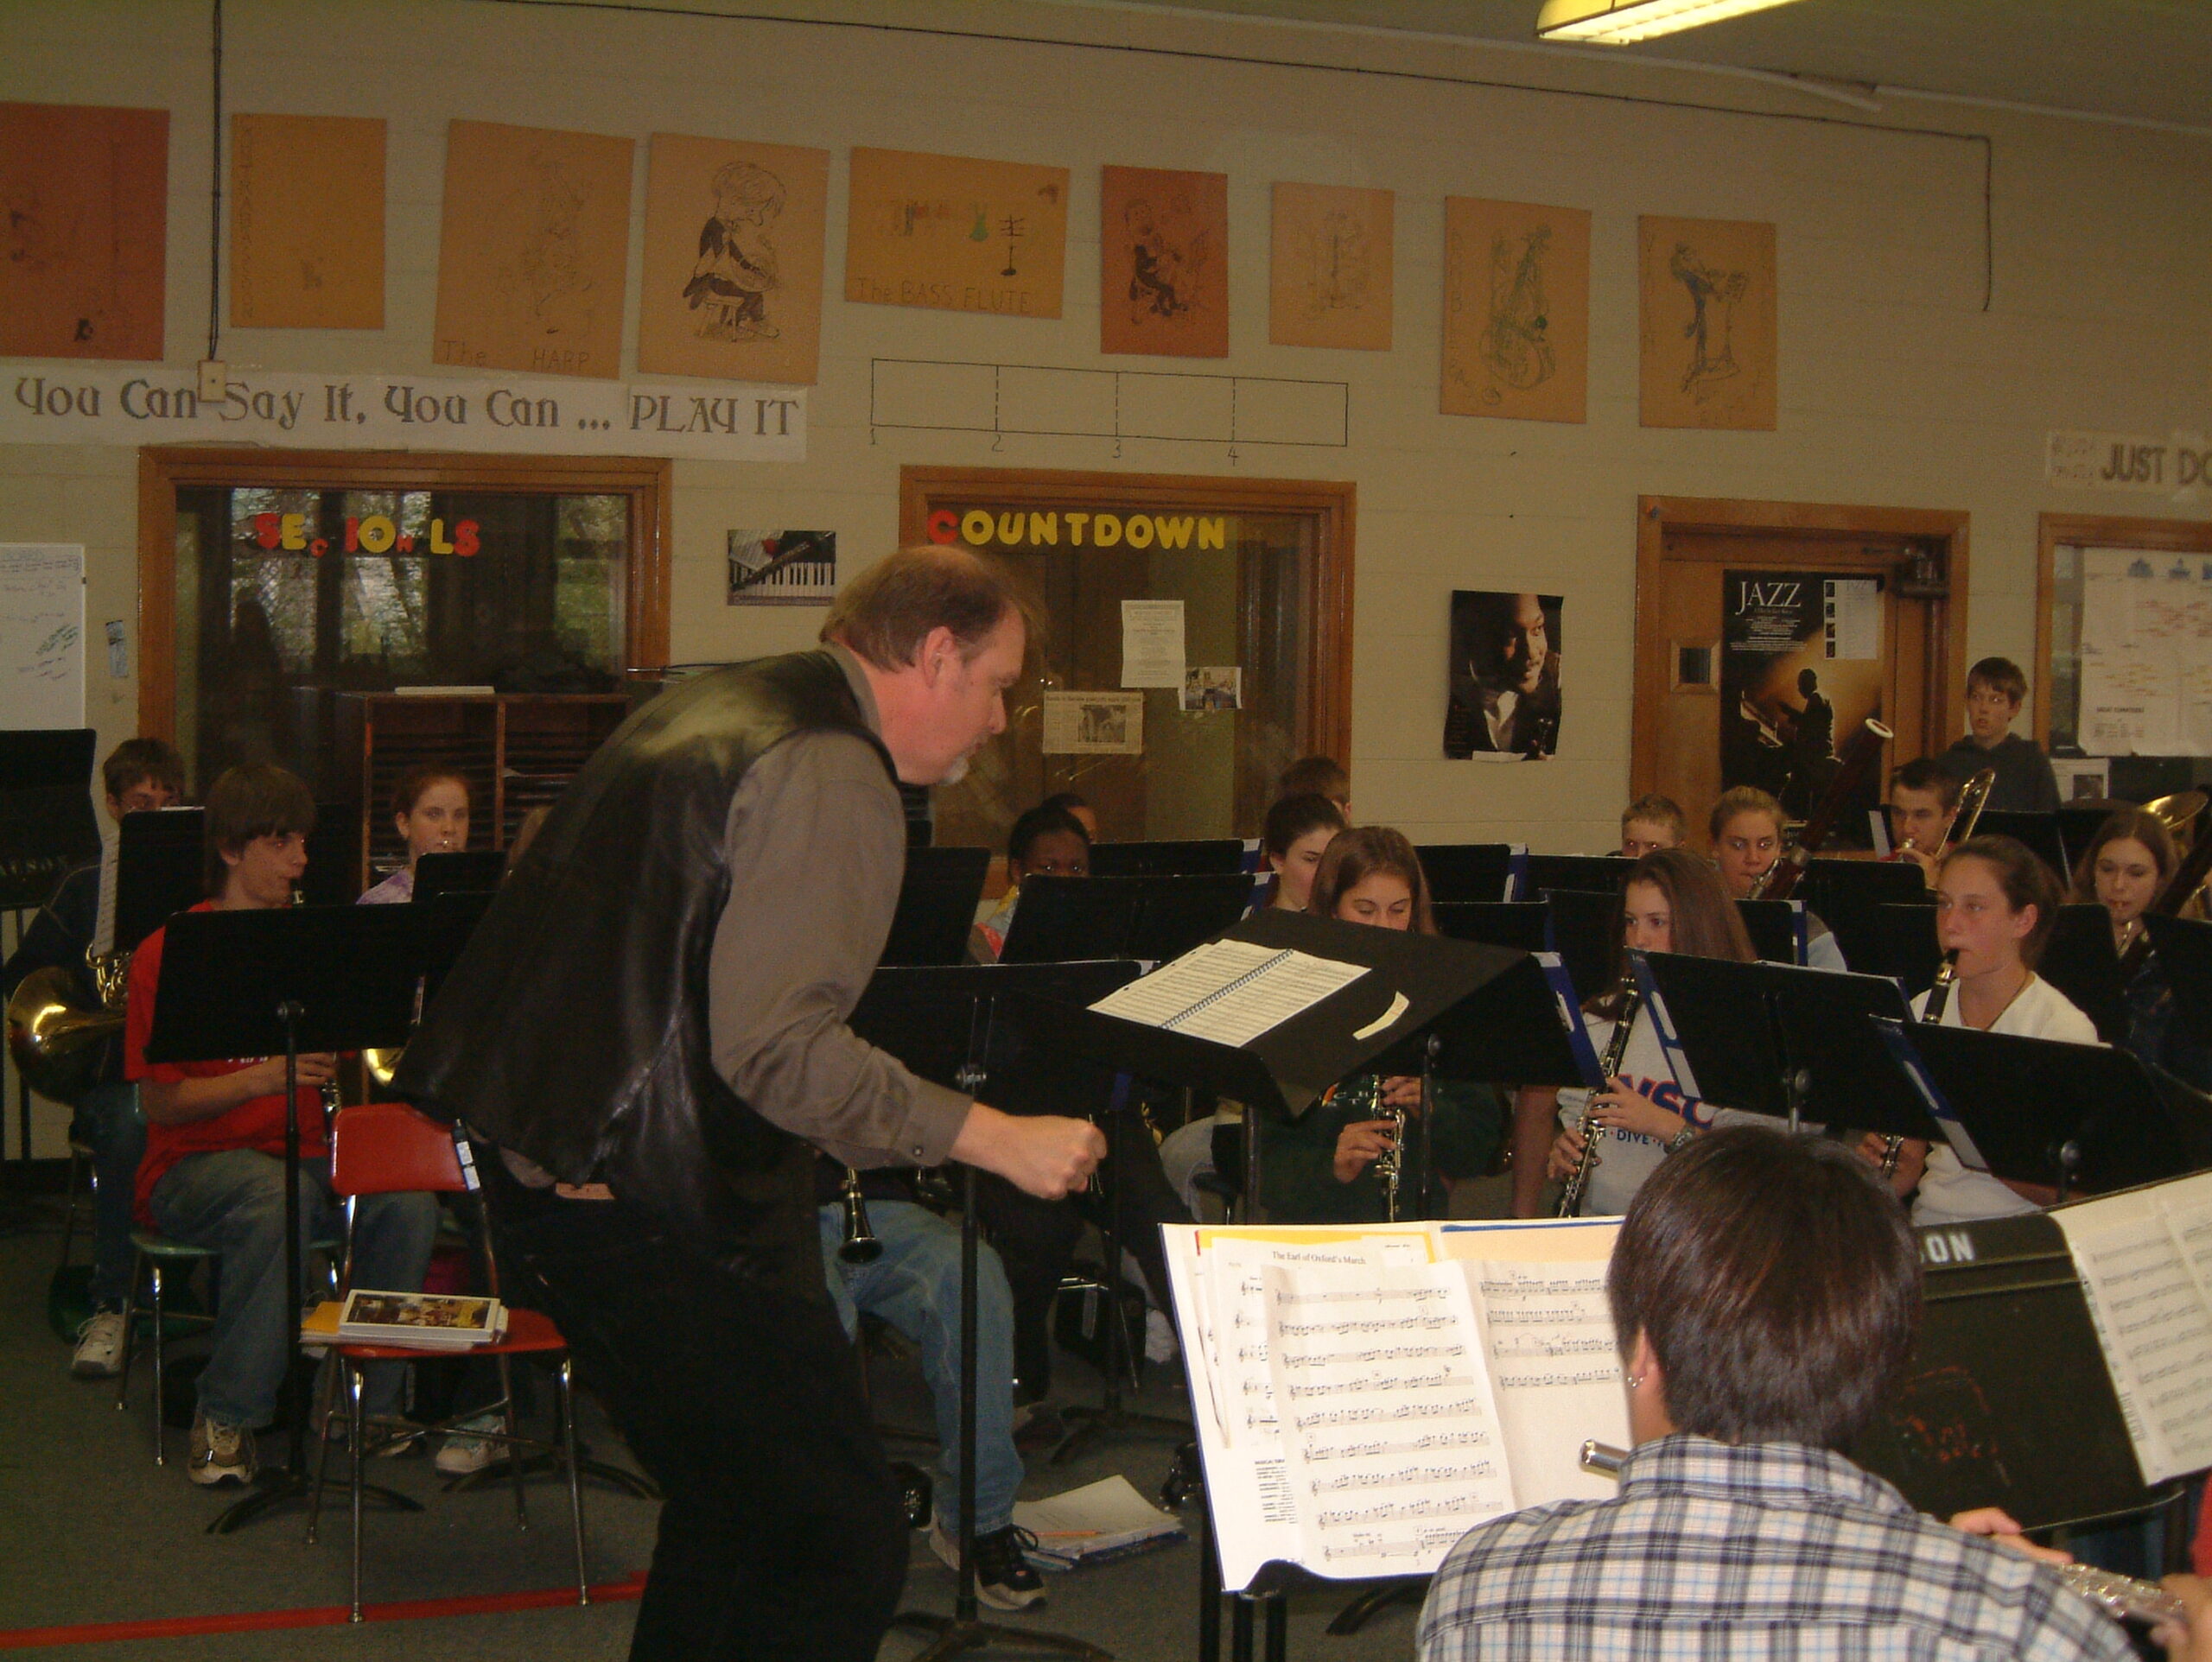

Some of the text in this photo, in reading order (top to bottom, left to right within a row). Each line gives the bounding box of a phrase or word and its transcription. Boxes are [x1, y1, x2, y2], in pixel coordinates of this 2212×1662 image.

[857, 276, 1031, 314] The BASS FLUTE
[441, 339, 590, 373] The HARP
[15, 377, 101, 417] You
[119, 378, 197, 419] Can
[219, 381, 304, 430] Say
[324, 383, 366, 425] It,
[384, 385, 468, 426] You
[486, 390, 560, 428] Can
[630, 395, 739, 435] PLAY
[755, 398, 799, 436] IT
[1112, 439, 1122, 459] 3
[1227, 445, 1240, 466] 4
[2100, 443, 2168, 484] JUST
[927, 509, 1224, 550] COUNTDOWN
[1734, 580, 1802, 616] JAZZ
[1617, 1129, 1649, 1145] DIVE
[1272, 1250, 1286, 1260] The
[1287, 1251, 1303, 1262] Earl
[1303, 1253, 1312, 1262] of
[1312, 1253, 1343, 1265] Oxford's
[1920, 1231, 1973, 1263] ON
